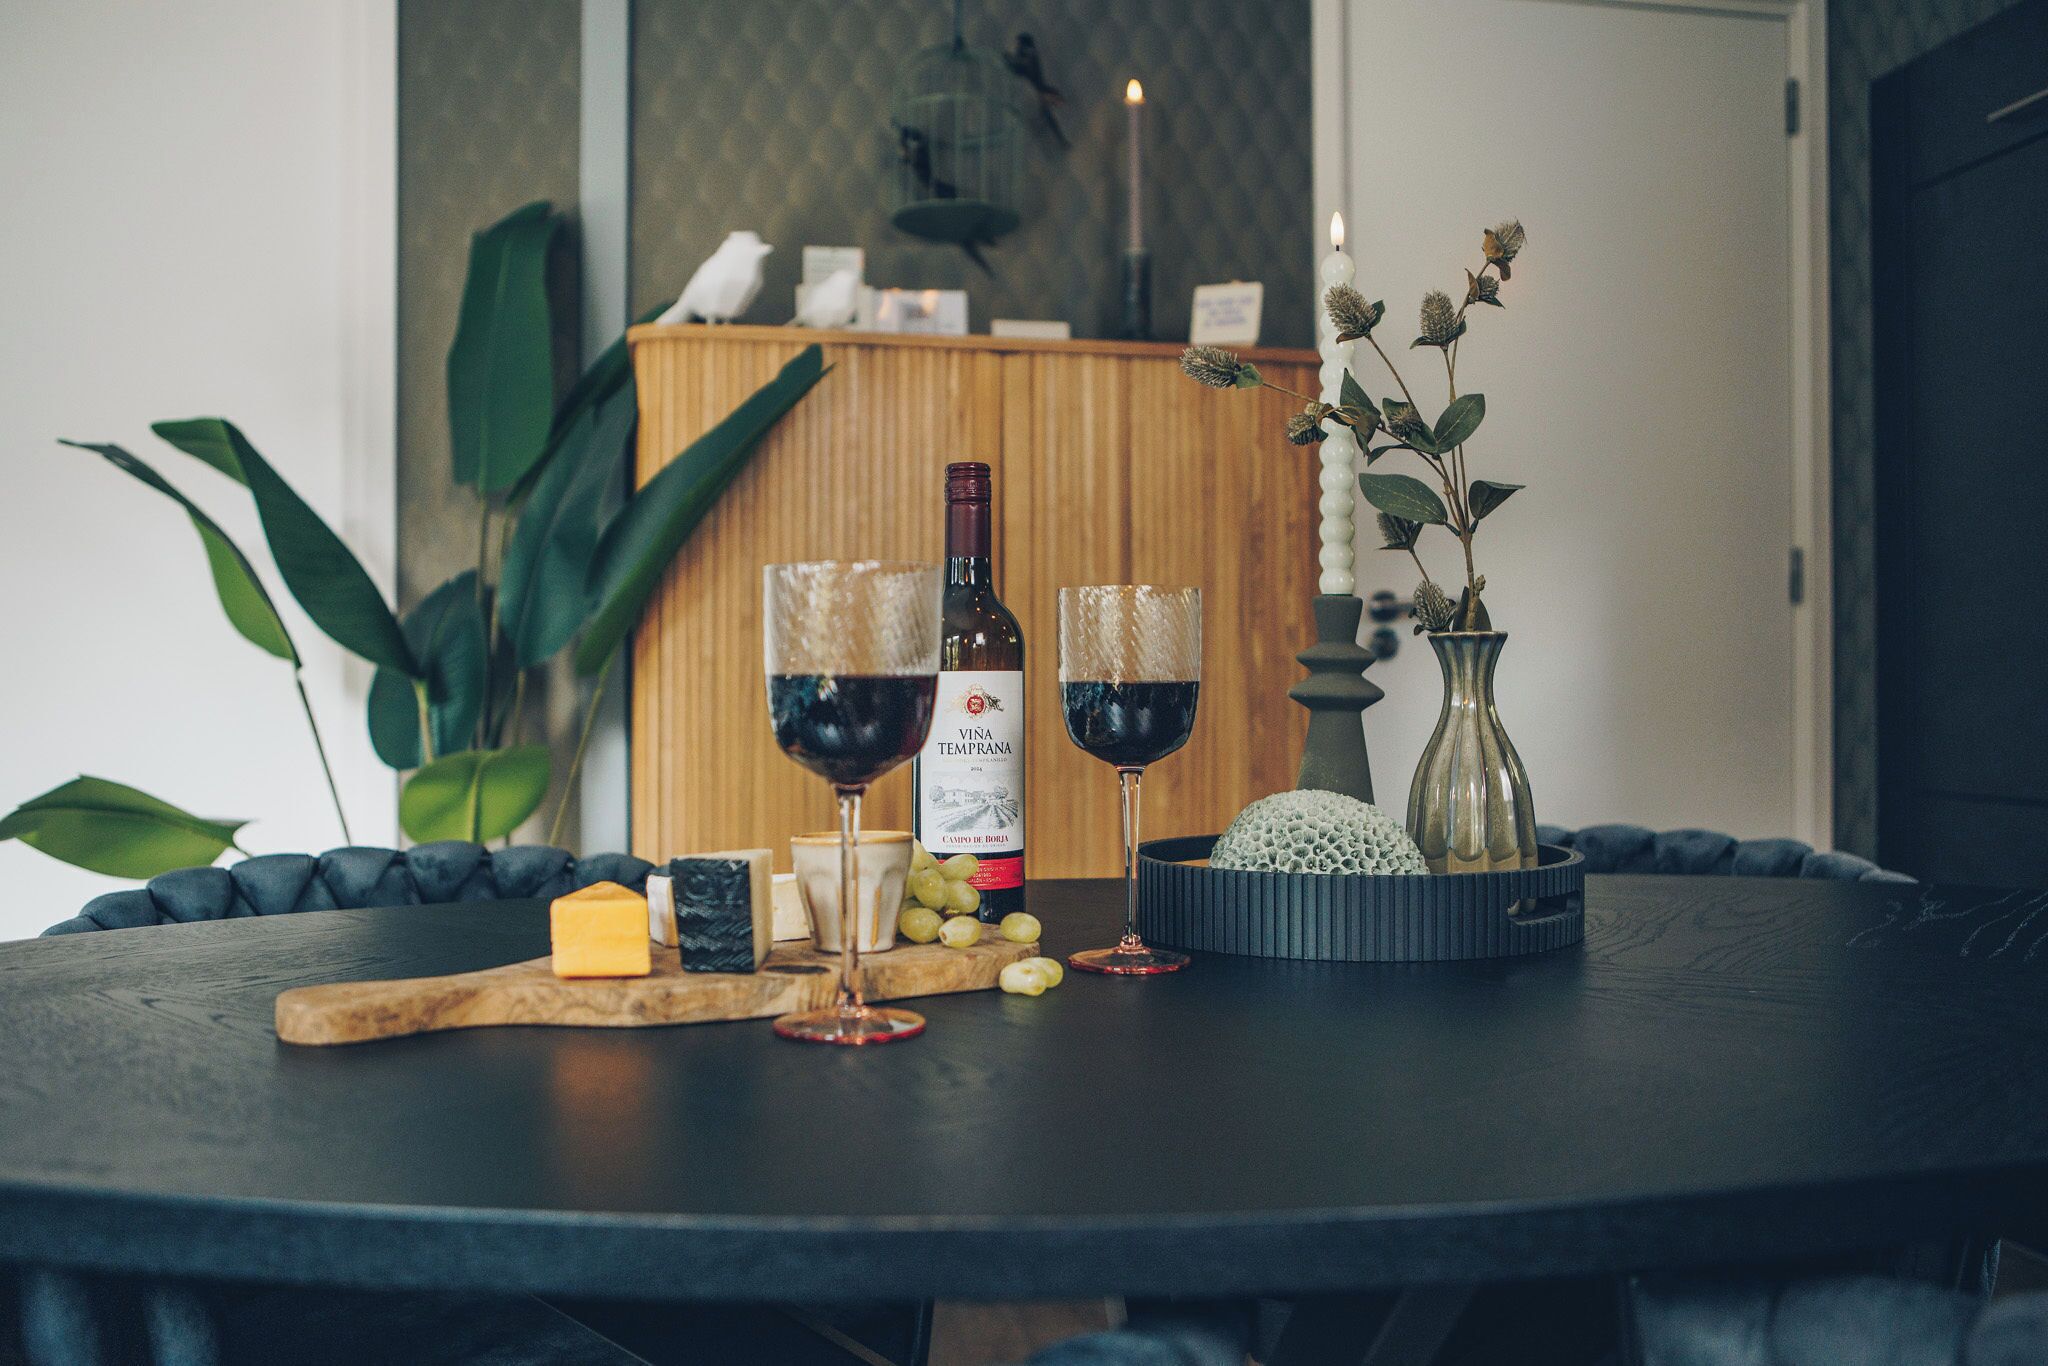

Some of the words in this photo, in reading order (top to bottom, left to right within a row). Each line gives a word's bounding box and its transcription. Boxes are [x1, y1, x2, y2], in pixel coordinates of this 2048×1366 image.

[958, 726, 992, 740] VIÑA
[938, 741, 1012, 755] TEMPRANA
[942, 835, 971, 843] CAMPO
[985, 834, 1009, 843] BORJA
